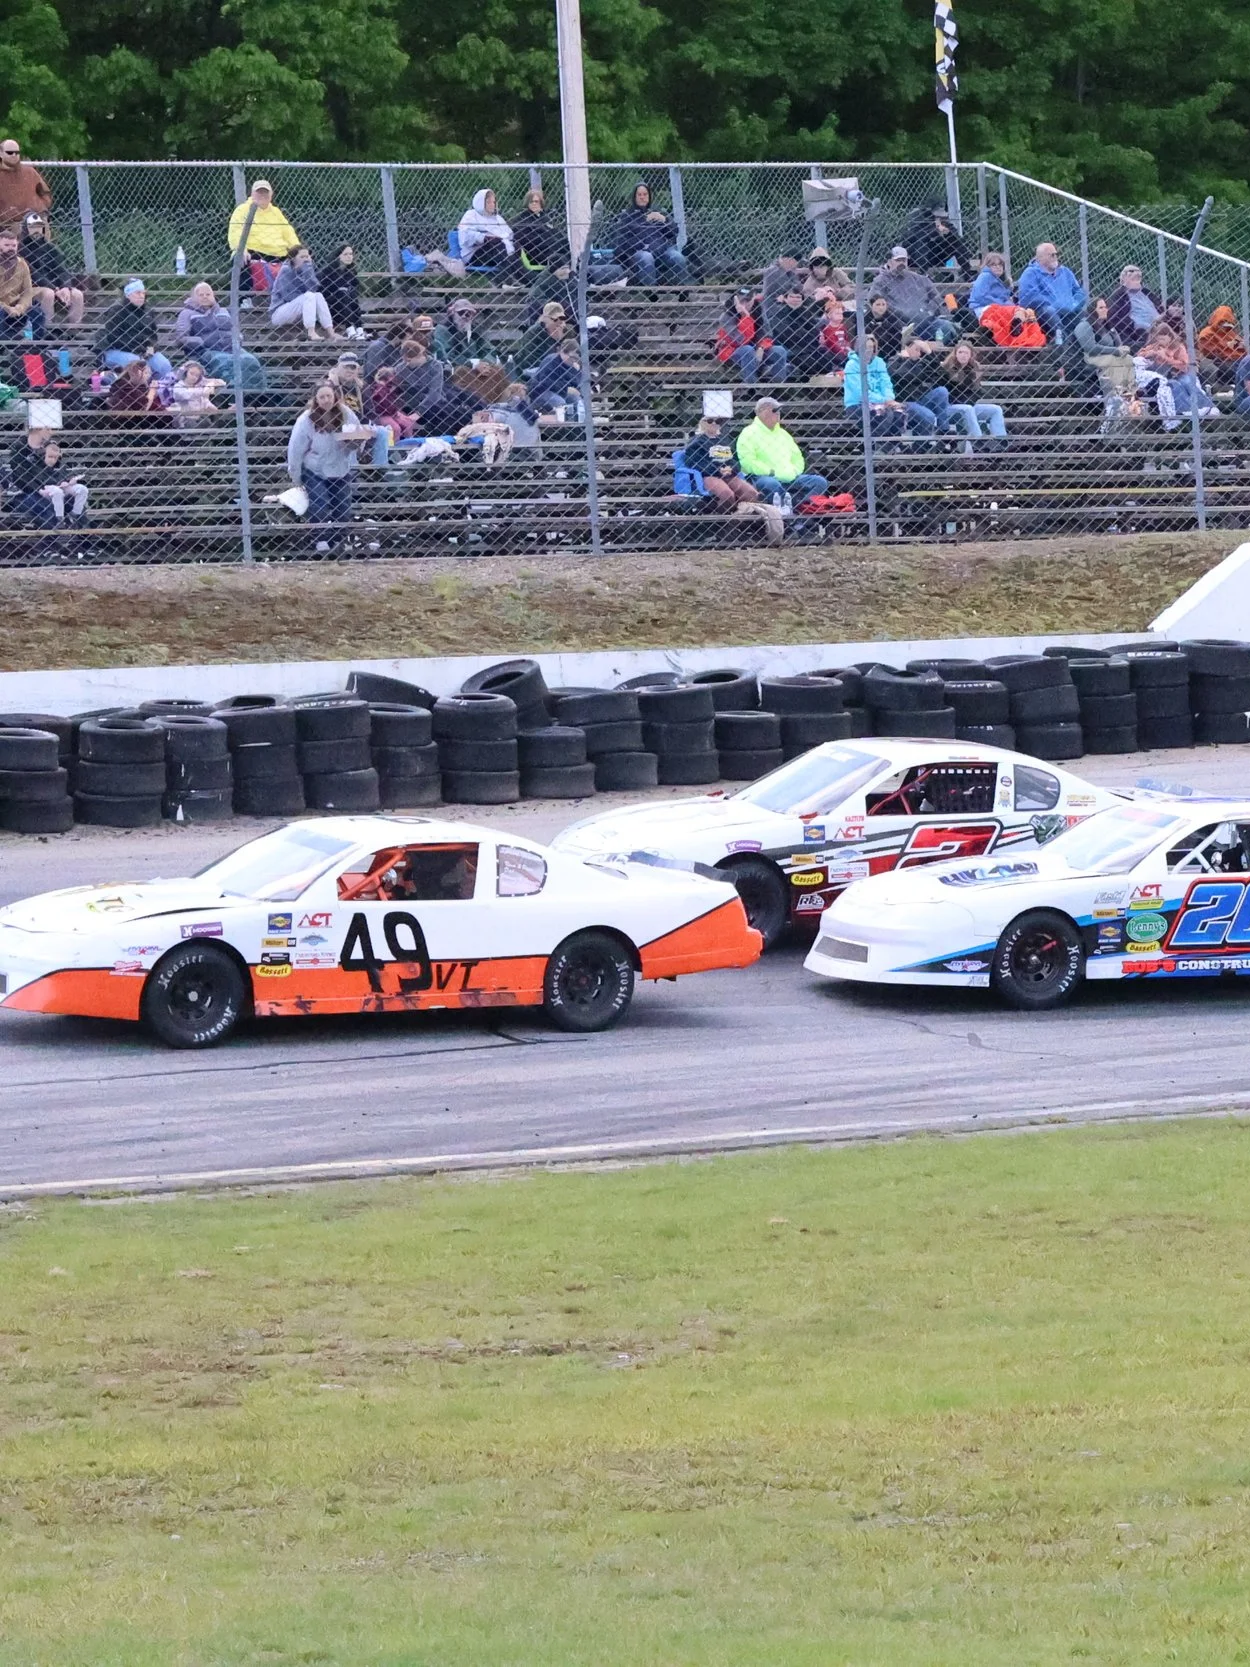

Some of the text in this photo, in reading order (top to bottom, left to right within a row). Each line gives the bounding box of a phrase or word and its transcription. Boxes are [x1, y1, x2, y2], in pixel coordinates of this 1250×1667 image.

[833, 825, 865, 839] ACT
[1130, 884, 1162, 899] ACT
[297, 912, 333, 928] ACT
[340, 911, 432, 993] 49
[1000, 928, 1022, 979] Hoosier
[1057, 945, 1080, 993] Hoosier
[1121, 959, 1176, 975] BOB'S
[157, 953, 204, 991] Hoosier
[435, 960, 480, 990] VT
[612, 960, 628, 1010] Hoosier
